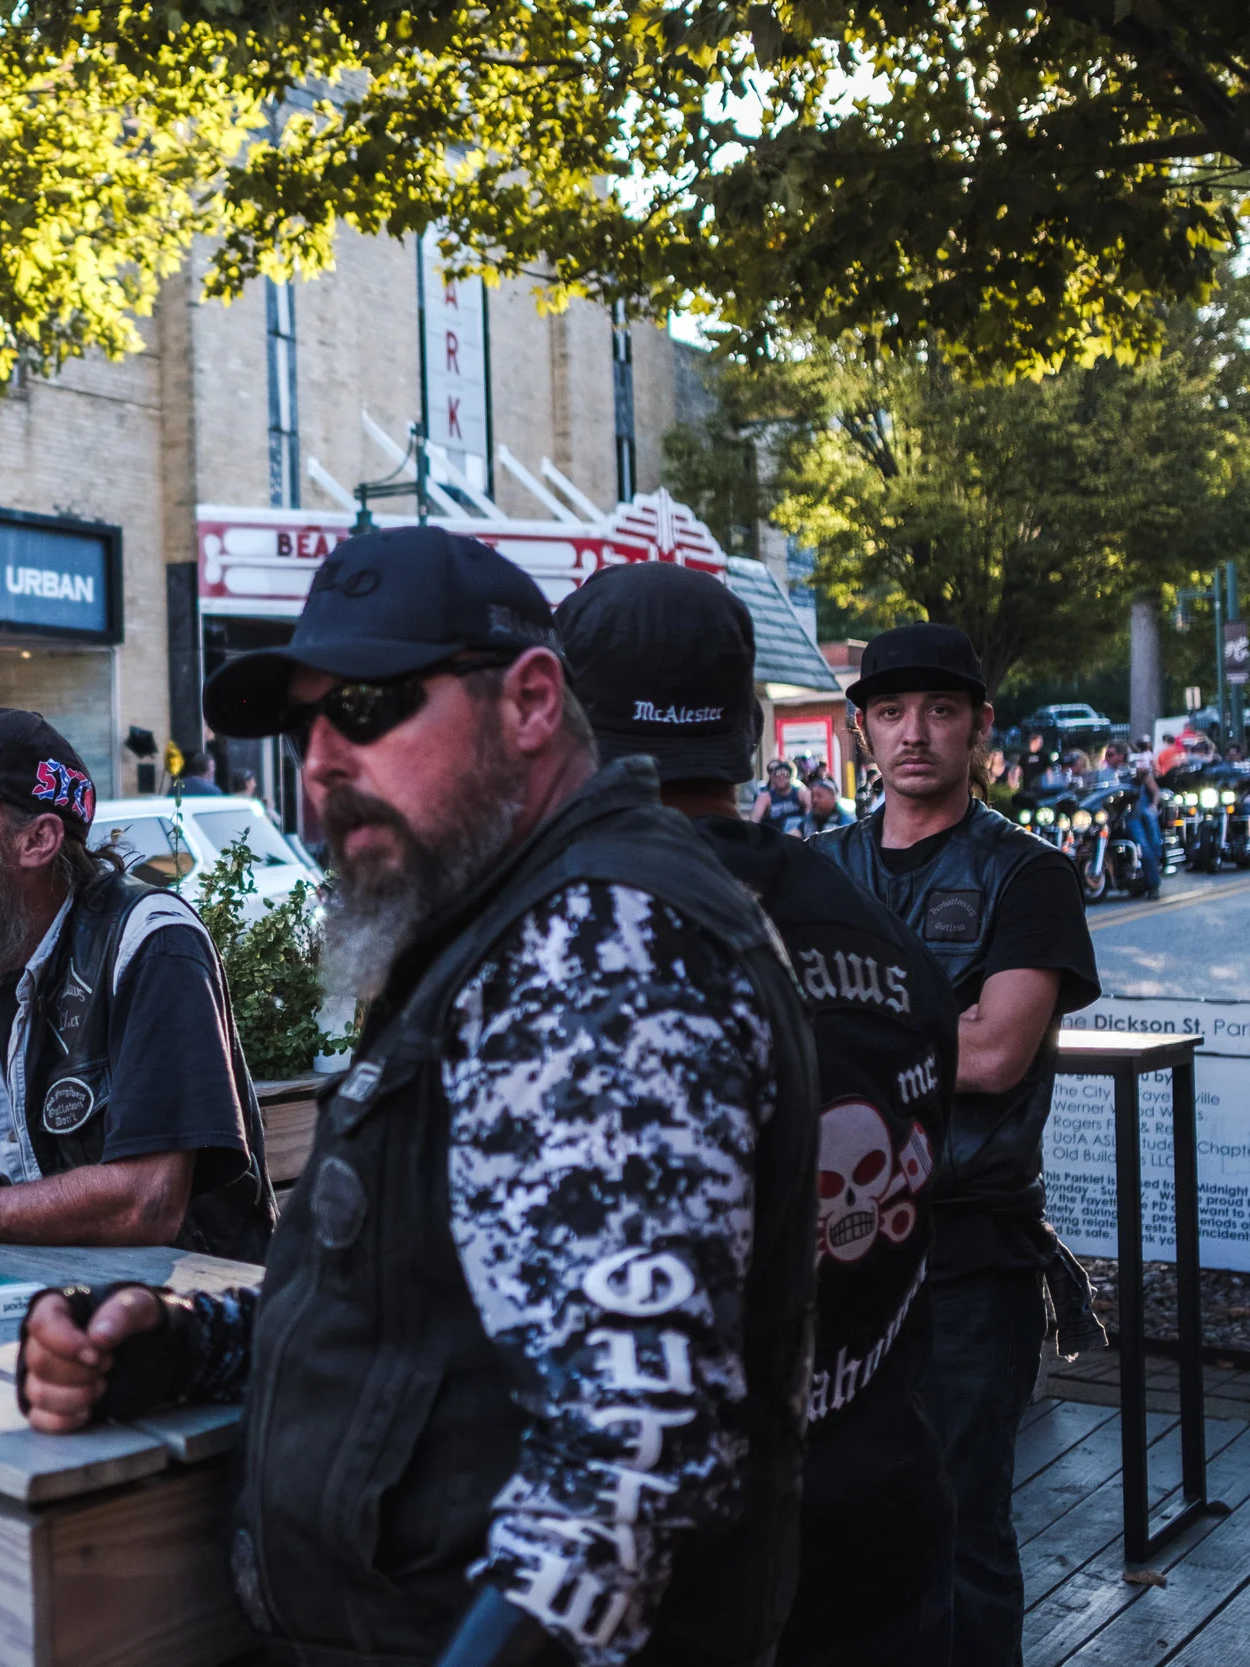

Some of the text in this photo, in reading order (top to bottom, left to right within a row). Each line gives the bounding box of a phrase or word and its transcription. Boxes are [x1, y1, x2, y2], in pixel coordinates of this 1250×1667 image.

[444, 281, 463, 441] ARK
[276, 532, 346, 558] BEA
[6, 565, 94, 604] URBAN
[632, 700, 725, 724] McAlester
[797, 948, 911, 1014] aws
[1094, 1014, 1176, 1034] Dickson
[1183, 1017, 1205, 1035] St.
[1214, 1018, 1250, 1037] Par
[1082, 1085, 1111, 1101] City
[1053, 1099, 1105, 1115] Werner
[1053, 1115, 1103, 1133] Rogers
[1053, 1147, 1079, 1161] Old
[1064, 1172, 1104, 1185] Parklet
[1059, 1193, 1077, 1204] the
[1152, 1200, 1168, 1211] PD
[1199, 1207, 1229, 1216] want
[1232, 1208, 1245, 1218] to
[1206, 1196, 1243, 1208] proud
[1199, 1217, 1237, 1229] eriods
[1066, 1226, 1082, 1237] be
[1159, 1235, 1175, 1247] yo
